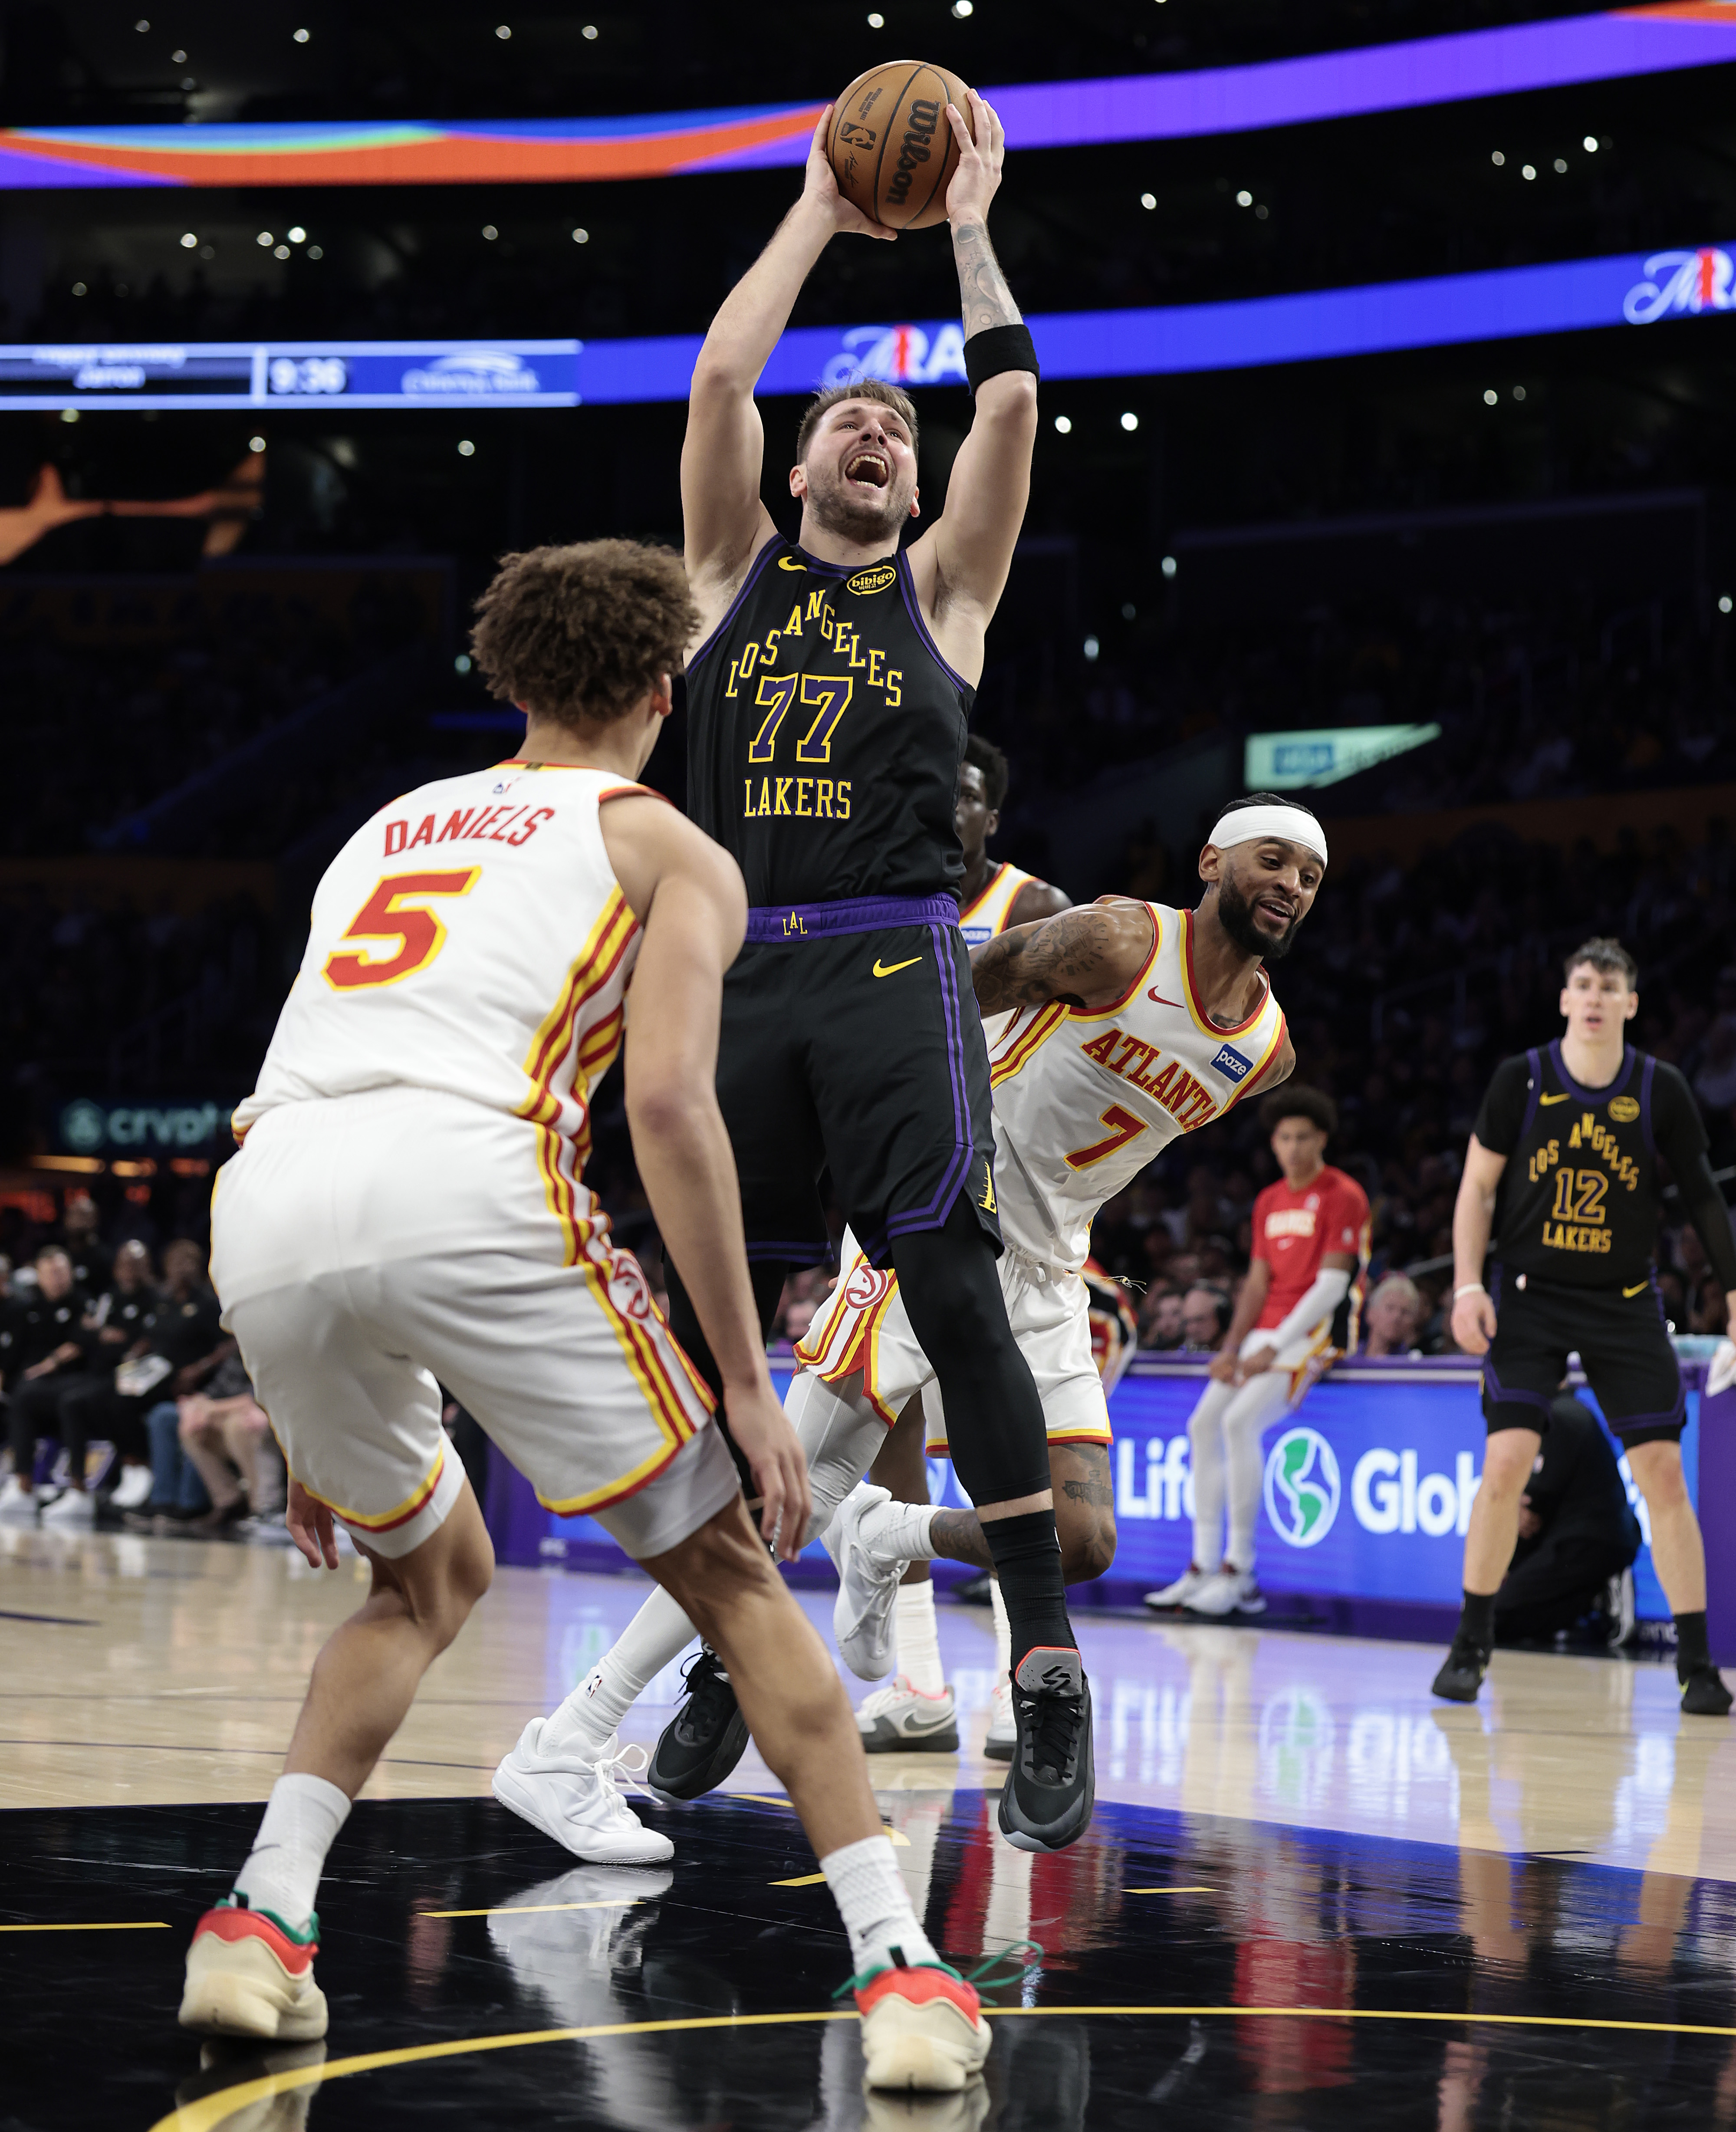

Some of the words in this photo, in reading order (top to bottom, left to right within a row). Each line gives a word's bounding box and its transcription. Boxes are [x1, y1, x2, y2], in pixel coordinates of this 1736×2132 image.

[885, 99, 940, 206] Wilson
[852, 572, 893, 587] bibigo
[725, 629, 781, 698] LOS
[783, 589, 904, 707] ANGELES
[748, 673, 854, 763] 77
[743, 776, 852, 819] LAKERS
[384, 805, 555, 857] DANIELS
[321, 865, 482, 992] 5
[783, 911, 808, 936] LAL
[1217, 1049, 1247, 1076] paze
[1063, 1103, 1149, 1172] 7
[1529, 1139, 1560, 1183] LOS
[1568, 1112, 1640, 1191] ANGELES
[1552, 1167, 1609, 1225] 12
[1542, 1221, 1612, 1254] LAKERS
